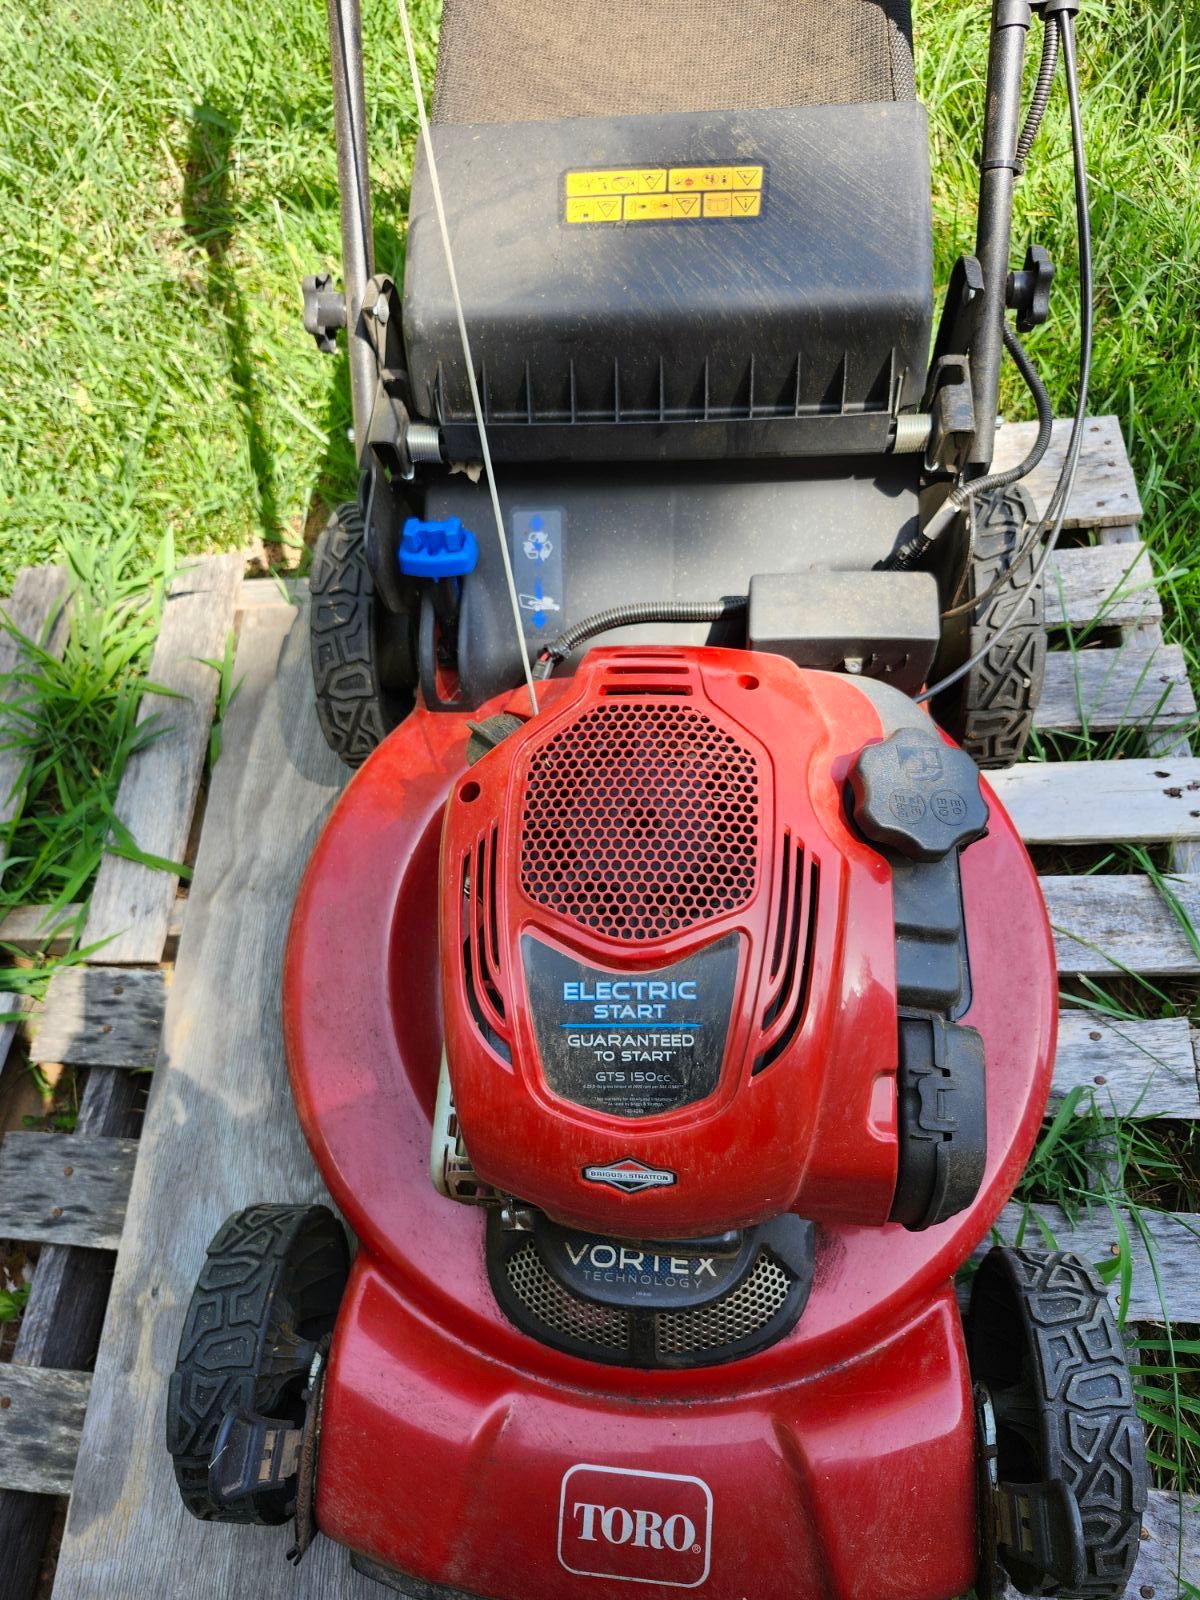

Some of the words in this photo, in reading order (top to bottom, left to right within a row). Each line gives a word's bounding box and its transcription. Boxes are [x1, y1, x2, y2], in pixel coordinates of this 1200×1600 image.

[563, 981, 697, 1001] ELECTRIC
[593, 1004, 666, 1019] START
[567, 1034, 695, 1047] GUARANTEED
[594, 1050, 615, 1062] TO
[595, 1071, 626, 1082] GTS
[630, 1071, 671, 1082] 150cc
[583, 1270, 703, 1289] TECHNOLOGY
